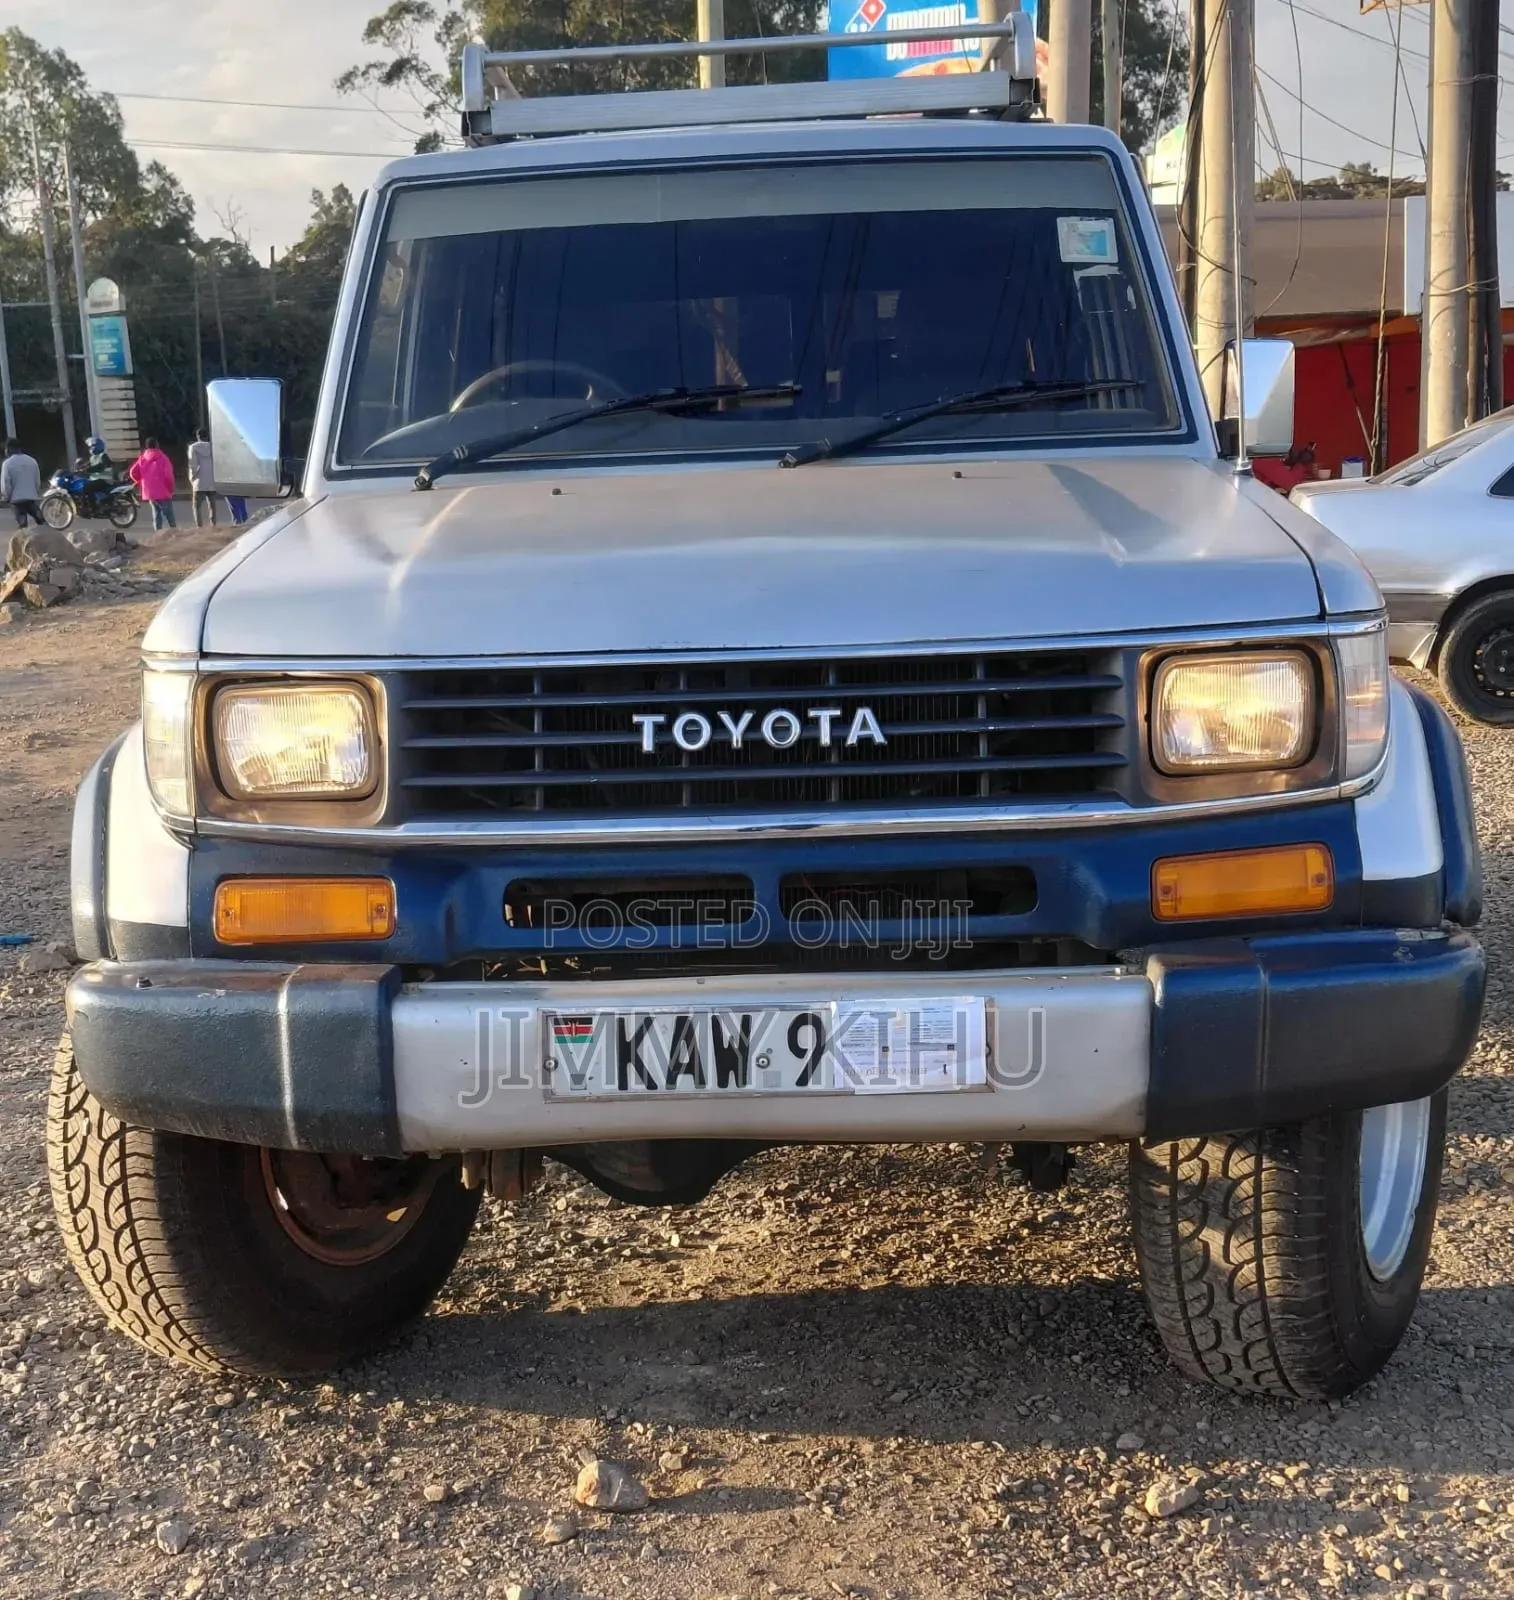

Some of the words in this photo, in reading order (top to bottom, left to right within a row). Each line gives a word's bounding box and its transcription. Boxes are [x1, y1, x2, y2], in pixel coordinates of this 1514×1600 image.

[632, 707, 888, 753] TOYOTA
[617, 1014, 753, 1090] KAW
[787, 1013, 826, 1087] 9
